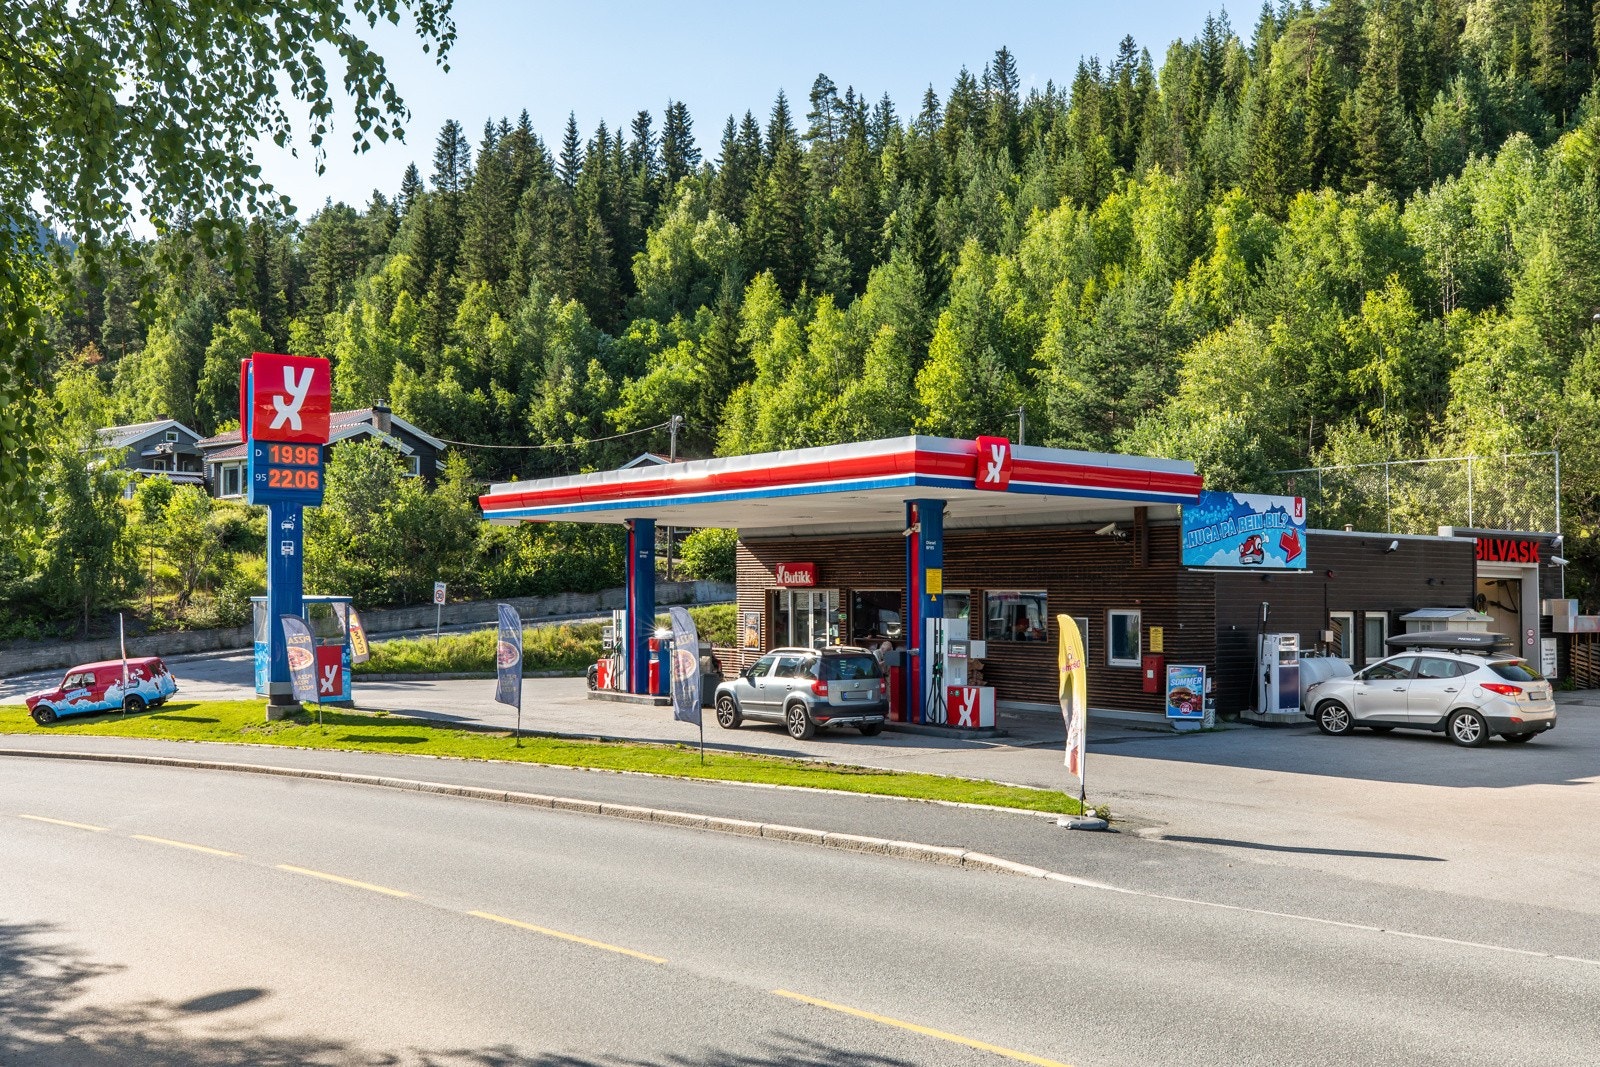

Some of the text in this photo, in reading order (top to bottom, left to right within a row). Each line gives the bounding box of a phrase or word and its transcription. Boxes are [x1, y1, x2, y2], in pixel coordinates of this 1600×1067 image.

[255, 445, 319, 465] D 19.96
[255, 469, 319, 489] 95 22.06
[1187, 512, 1289, 549] HUGA PÅ REIN BIL?
[1476, 538, 1541, 563] BILVASK
[784, 571, 811, 584] Butikk
[1170, 677, 1202, 687] SOMMER
